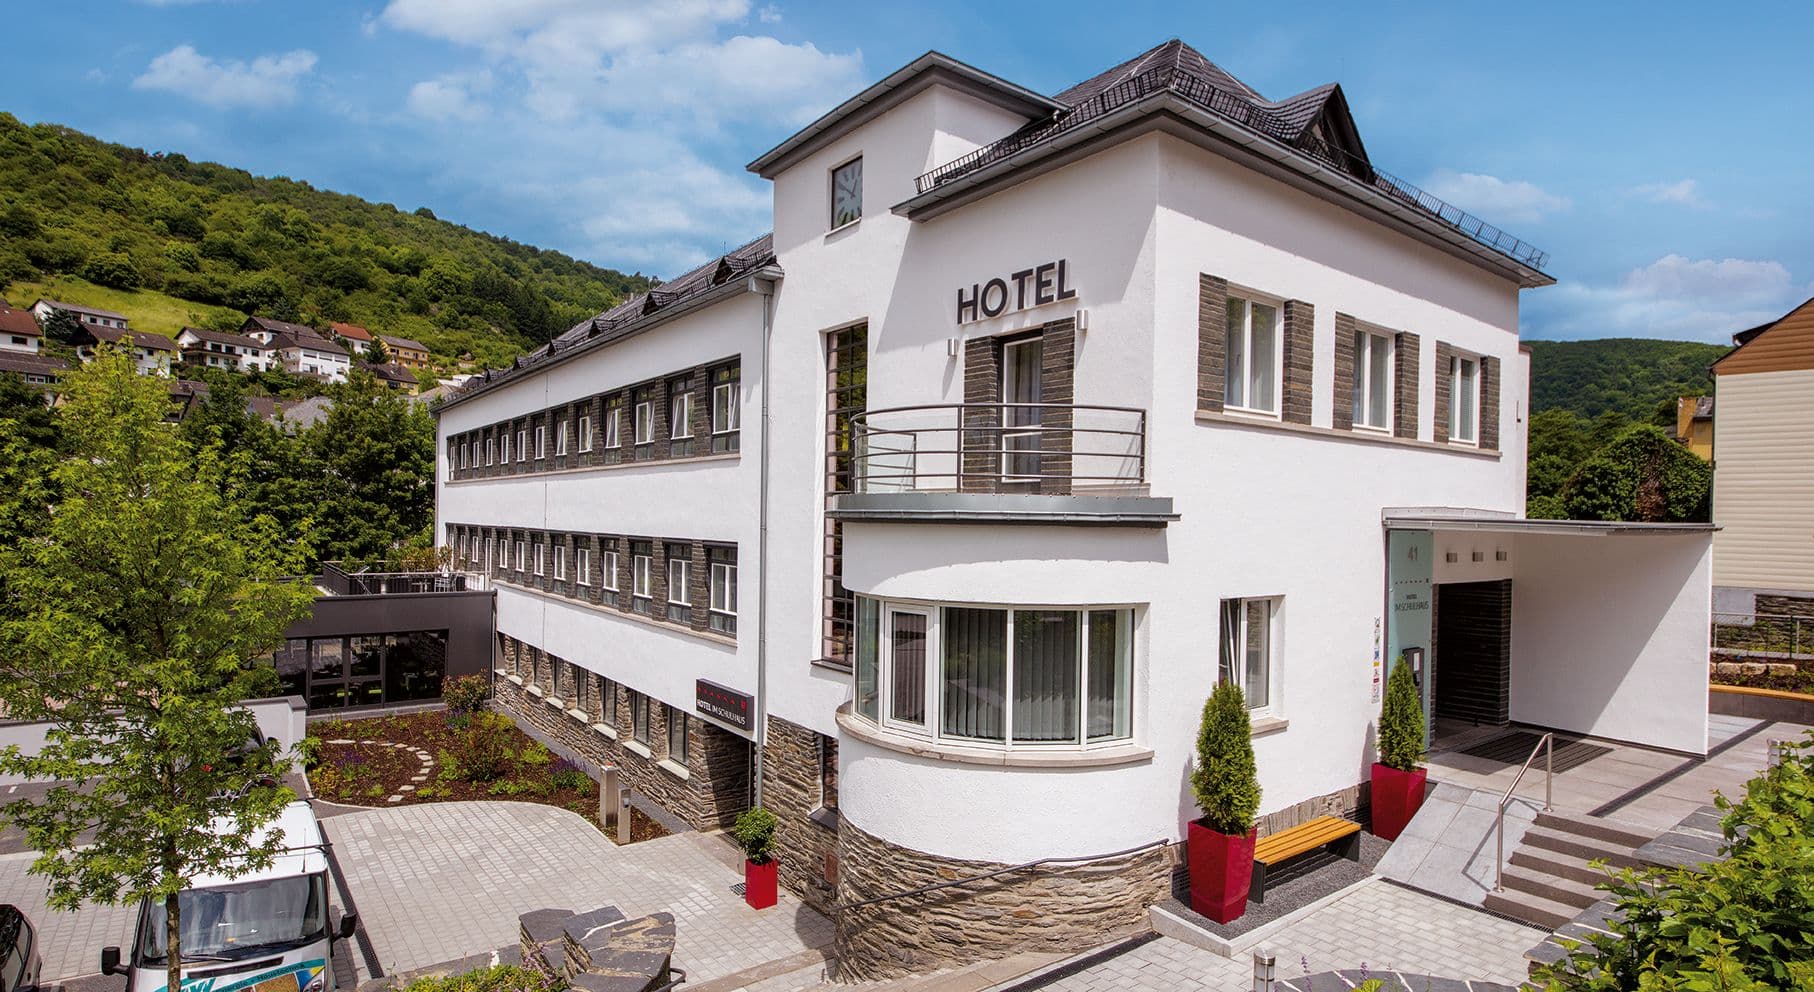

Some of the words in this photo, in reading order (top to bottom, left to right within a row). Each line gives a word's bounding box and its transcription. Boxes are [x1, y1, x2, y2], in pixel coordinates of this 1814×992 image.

[957, 259, 1076, 325] HOTEL
[1408, 546, 1418, 561] 41
[696, 699, 711, 712] HOTEL
[712, 704, 718, 714] IM
[718, 707, 746, 725] SCHULHAUS
